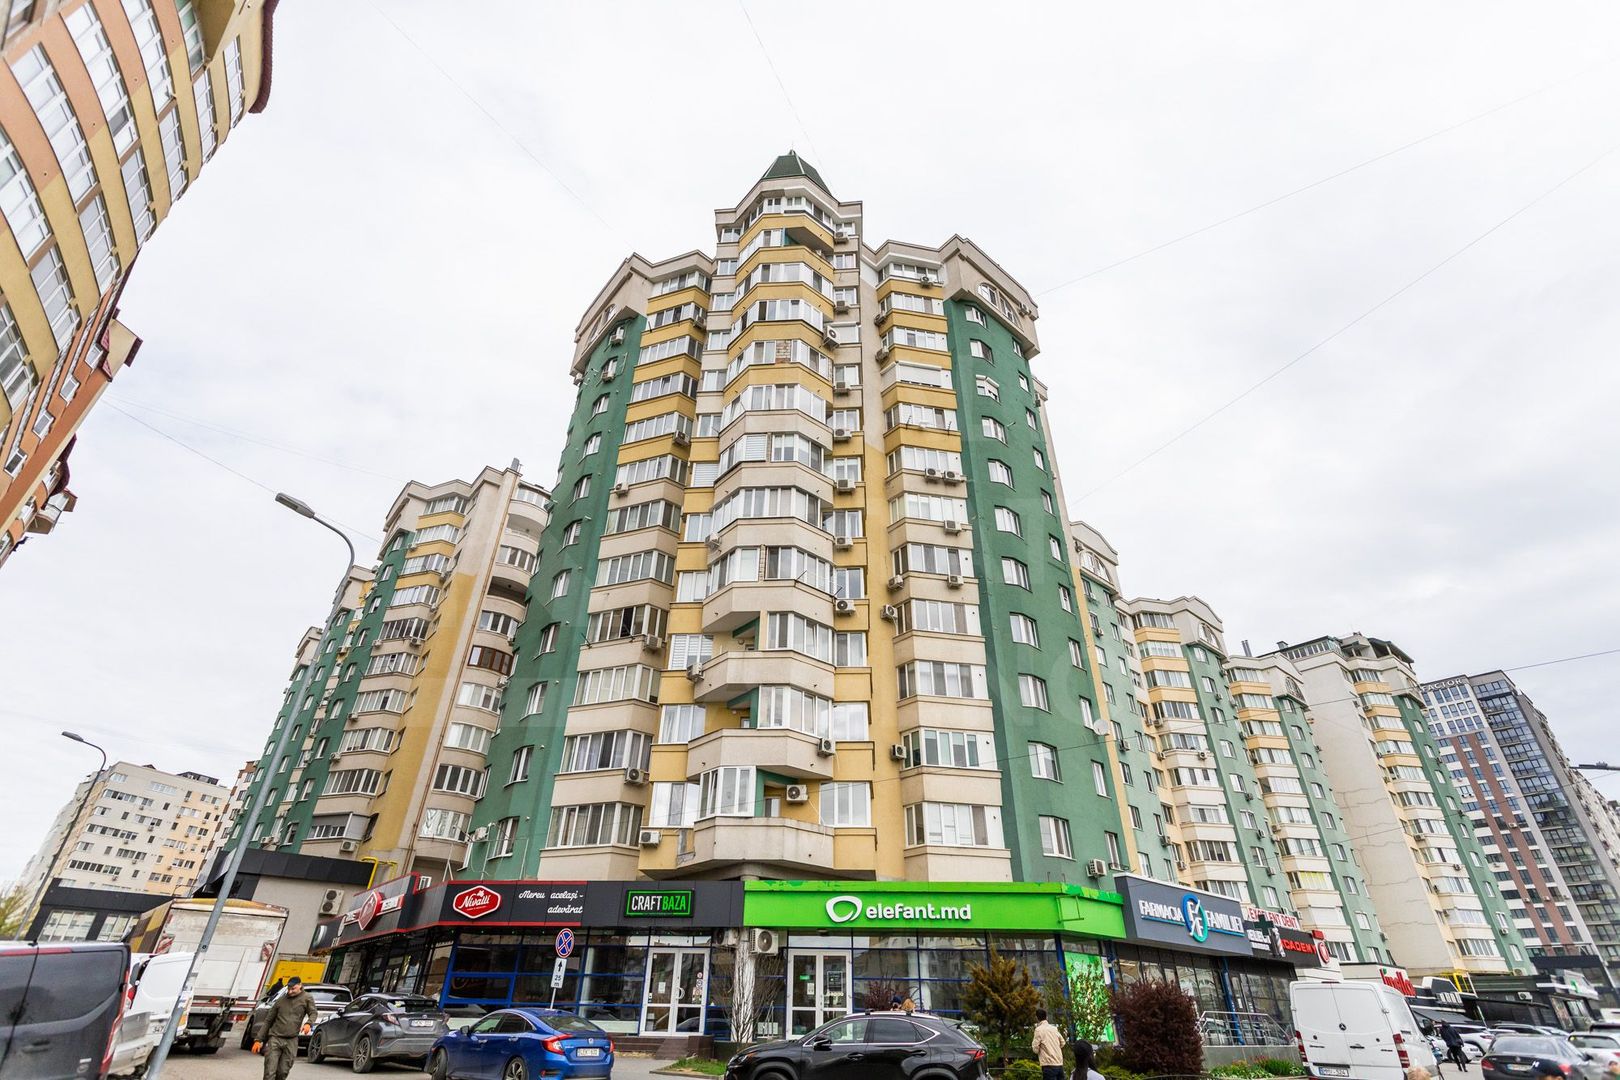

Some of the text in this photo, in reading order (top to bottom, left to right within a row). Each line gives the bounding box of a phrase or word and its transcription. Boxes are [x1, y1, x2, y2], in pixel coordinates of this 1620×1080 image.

[518, 890, 546, 899] Mereu
[865, 903, 972, 920] elefant.md
[1138, 899, 1185, 921] FARMACIA
